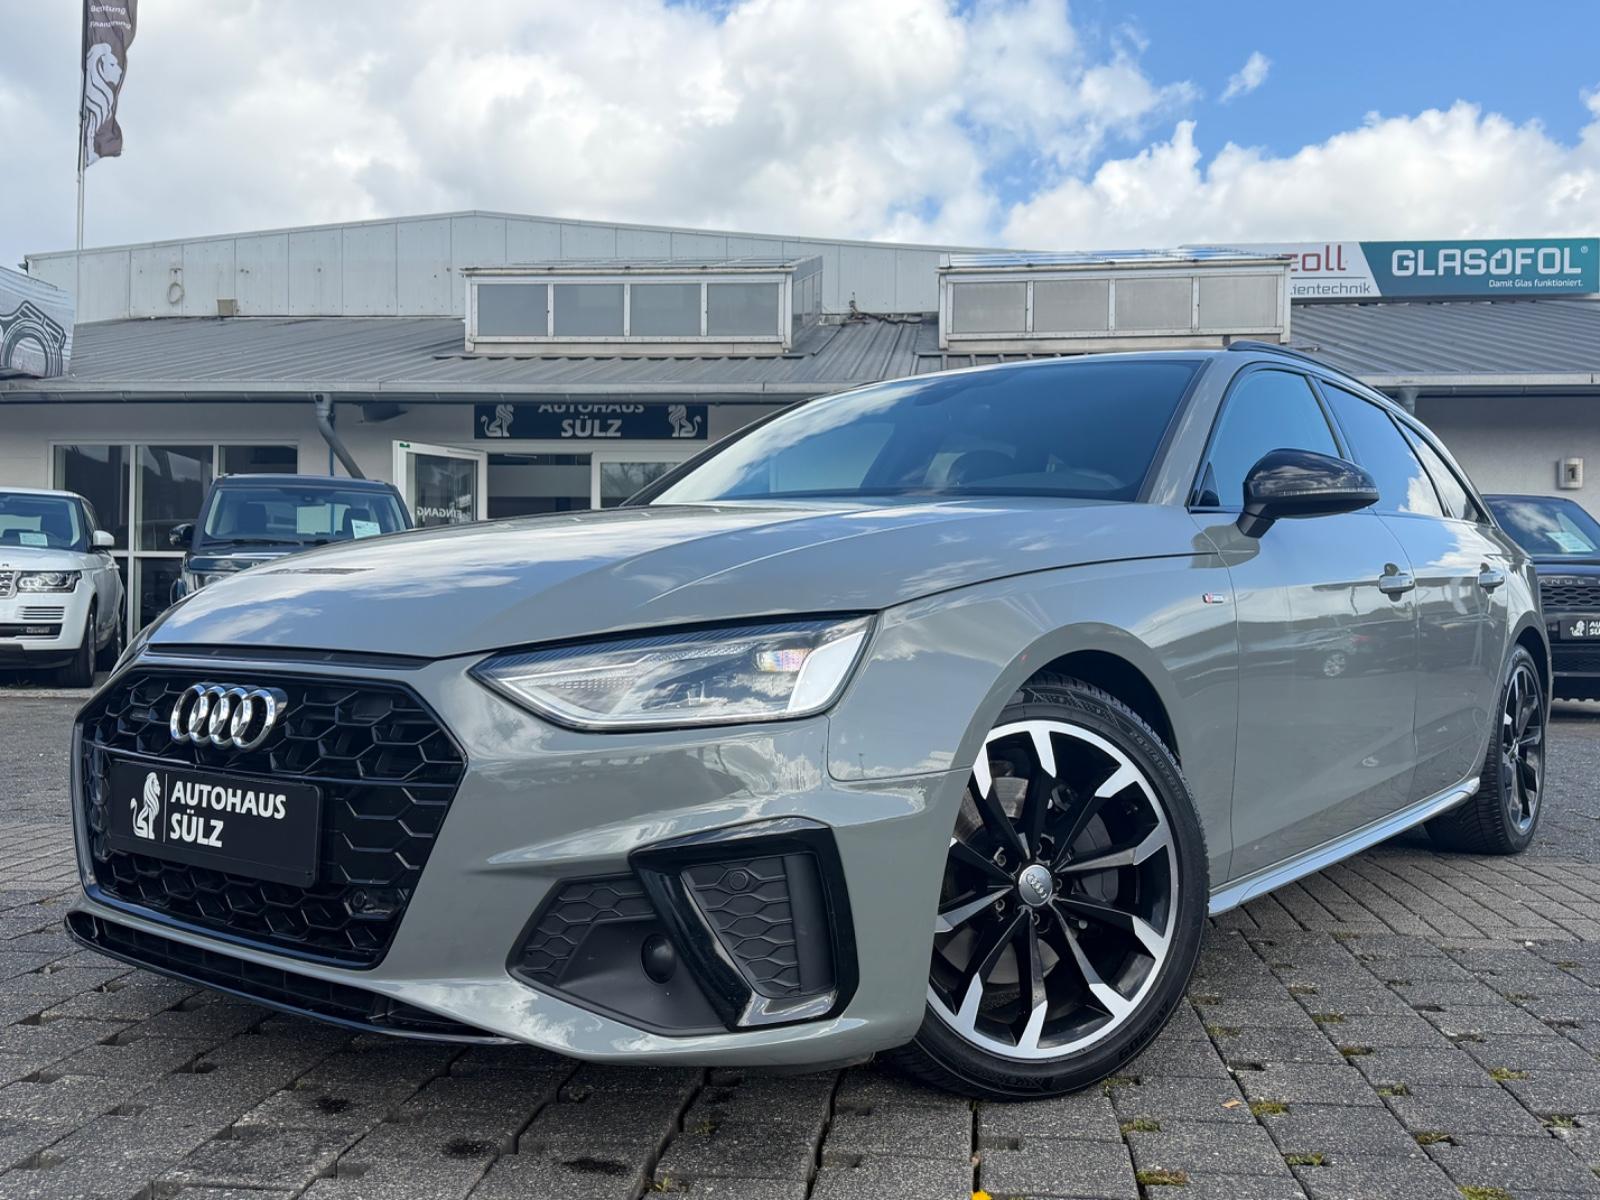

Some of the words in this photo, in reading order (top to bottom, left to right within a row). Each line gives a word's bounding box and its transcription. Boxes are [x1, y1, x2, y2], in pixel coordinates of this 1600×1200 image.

[1392, 247, 1582, 276] GLASOFOL
[1290, 282, 1371, 296] ientechnik
[1489, 279, 1513, 288] Damit
[1515, 279, 1533, 288] Glas
[1535, 278, 1584, 288] funktioniert.
[561, 415, 623, 438] SÜLZ
[170, 781, 287, 819] AUTOHAUS
[170, 808, 224, 848] SÜLZ
